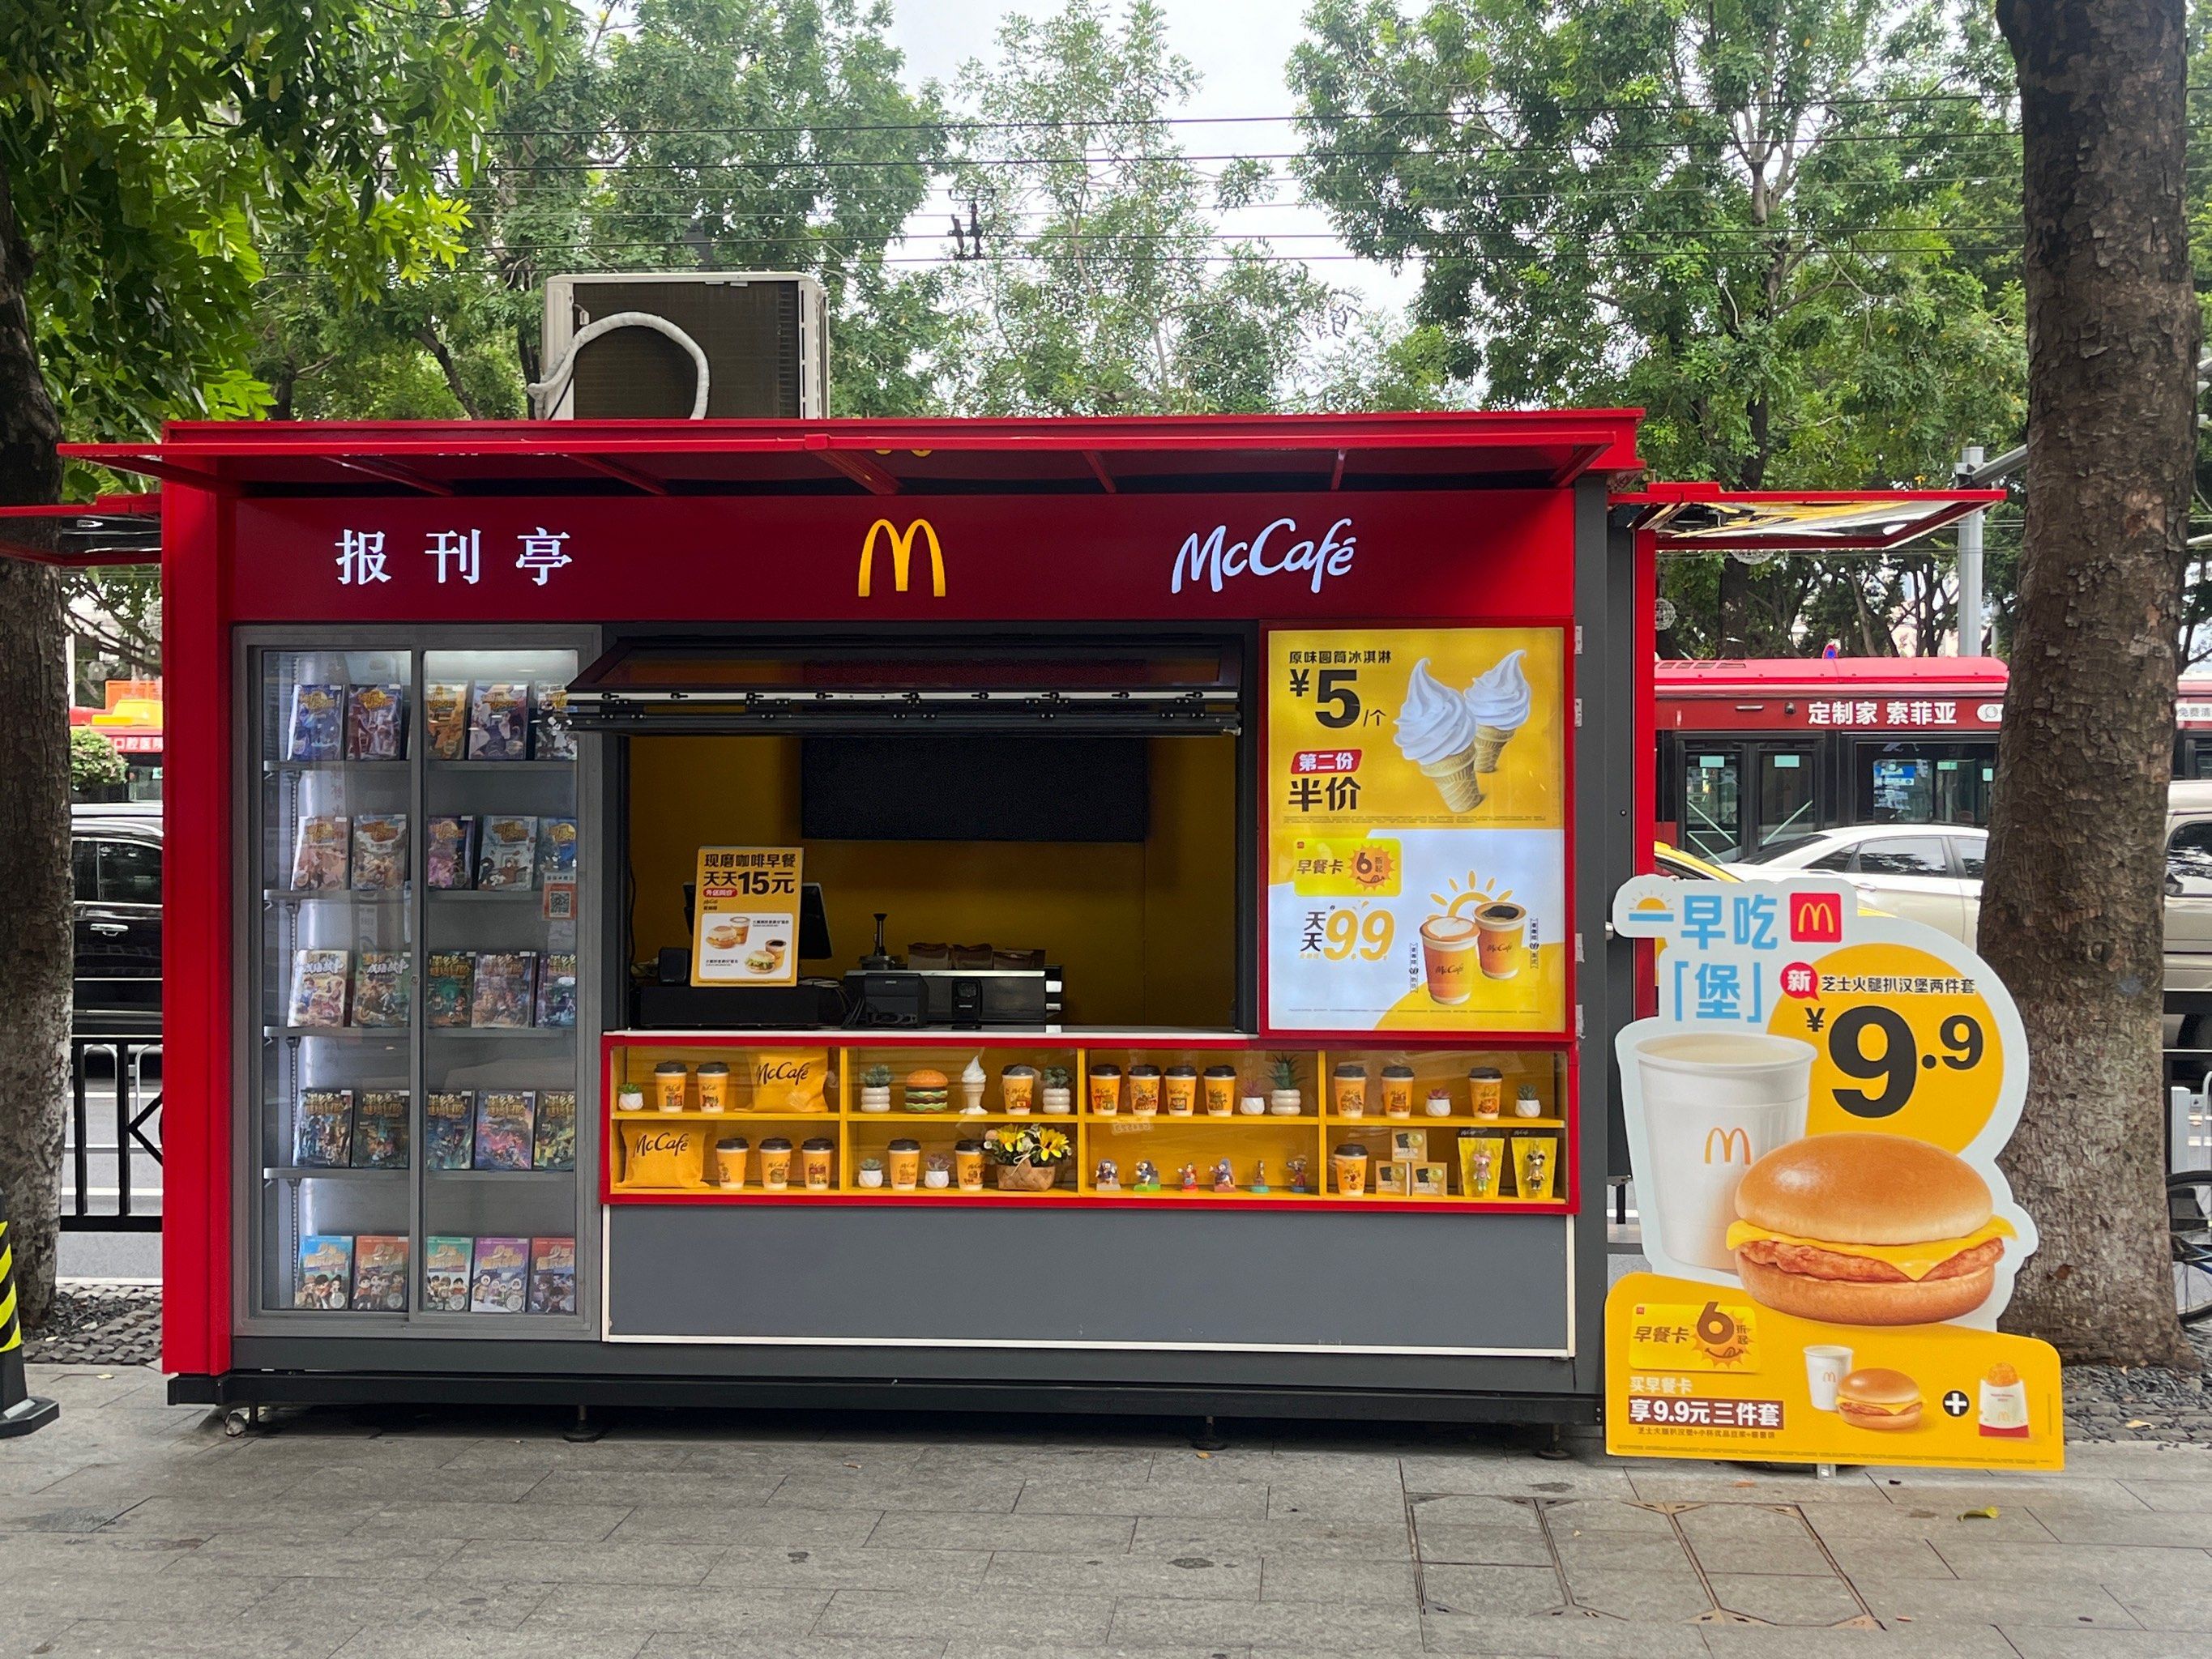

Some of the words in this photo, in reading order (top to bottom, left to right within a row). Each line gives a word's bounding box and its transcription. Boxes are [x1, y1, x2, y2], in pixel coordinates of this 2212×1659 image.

[335, 527, 572, 585] 报刊亭
[1171, 518, 1357, 594] McCafé
[1289, 650, 1392, 663] 原味圆筒冰淇淋
[1808, 702, 1877, 725] 定制家
[1886, 701, 1957, 726] 索菲亚
[1298, 752, 1355, 771] 第二份
[1288, 776, 1361, 812] 半价
[704, 853, 796, 868] 现磨咖啡早餐
[1297, 859, 1343, 874] 早餐卡
[703, 871, 795, 895] 天天15元
[1787, 970, 1811, 992] 新
[1821, 976, 1975, 995] 芝士火腿扒汉堡两件套
[754, 1061, 811, 1085] McCafé
[633, 1132, 690, 1158] McCafé
[1633, 1326, 1689, 1343] 早餐卡
[1697, 1301, 1735, 1345] 6
[1630, 1376, 1693, 1395] 买早餐卡
[1629, 1398, 1780, 1427] 享9.9元三件套
